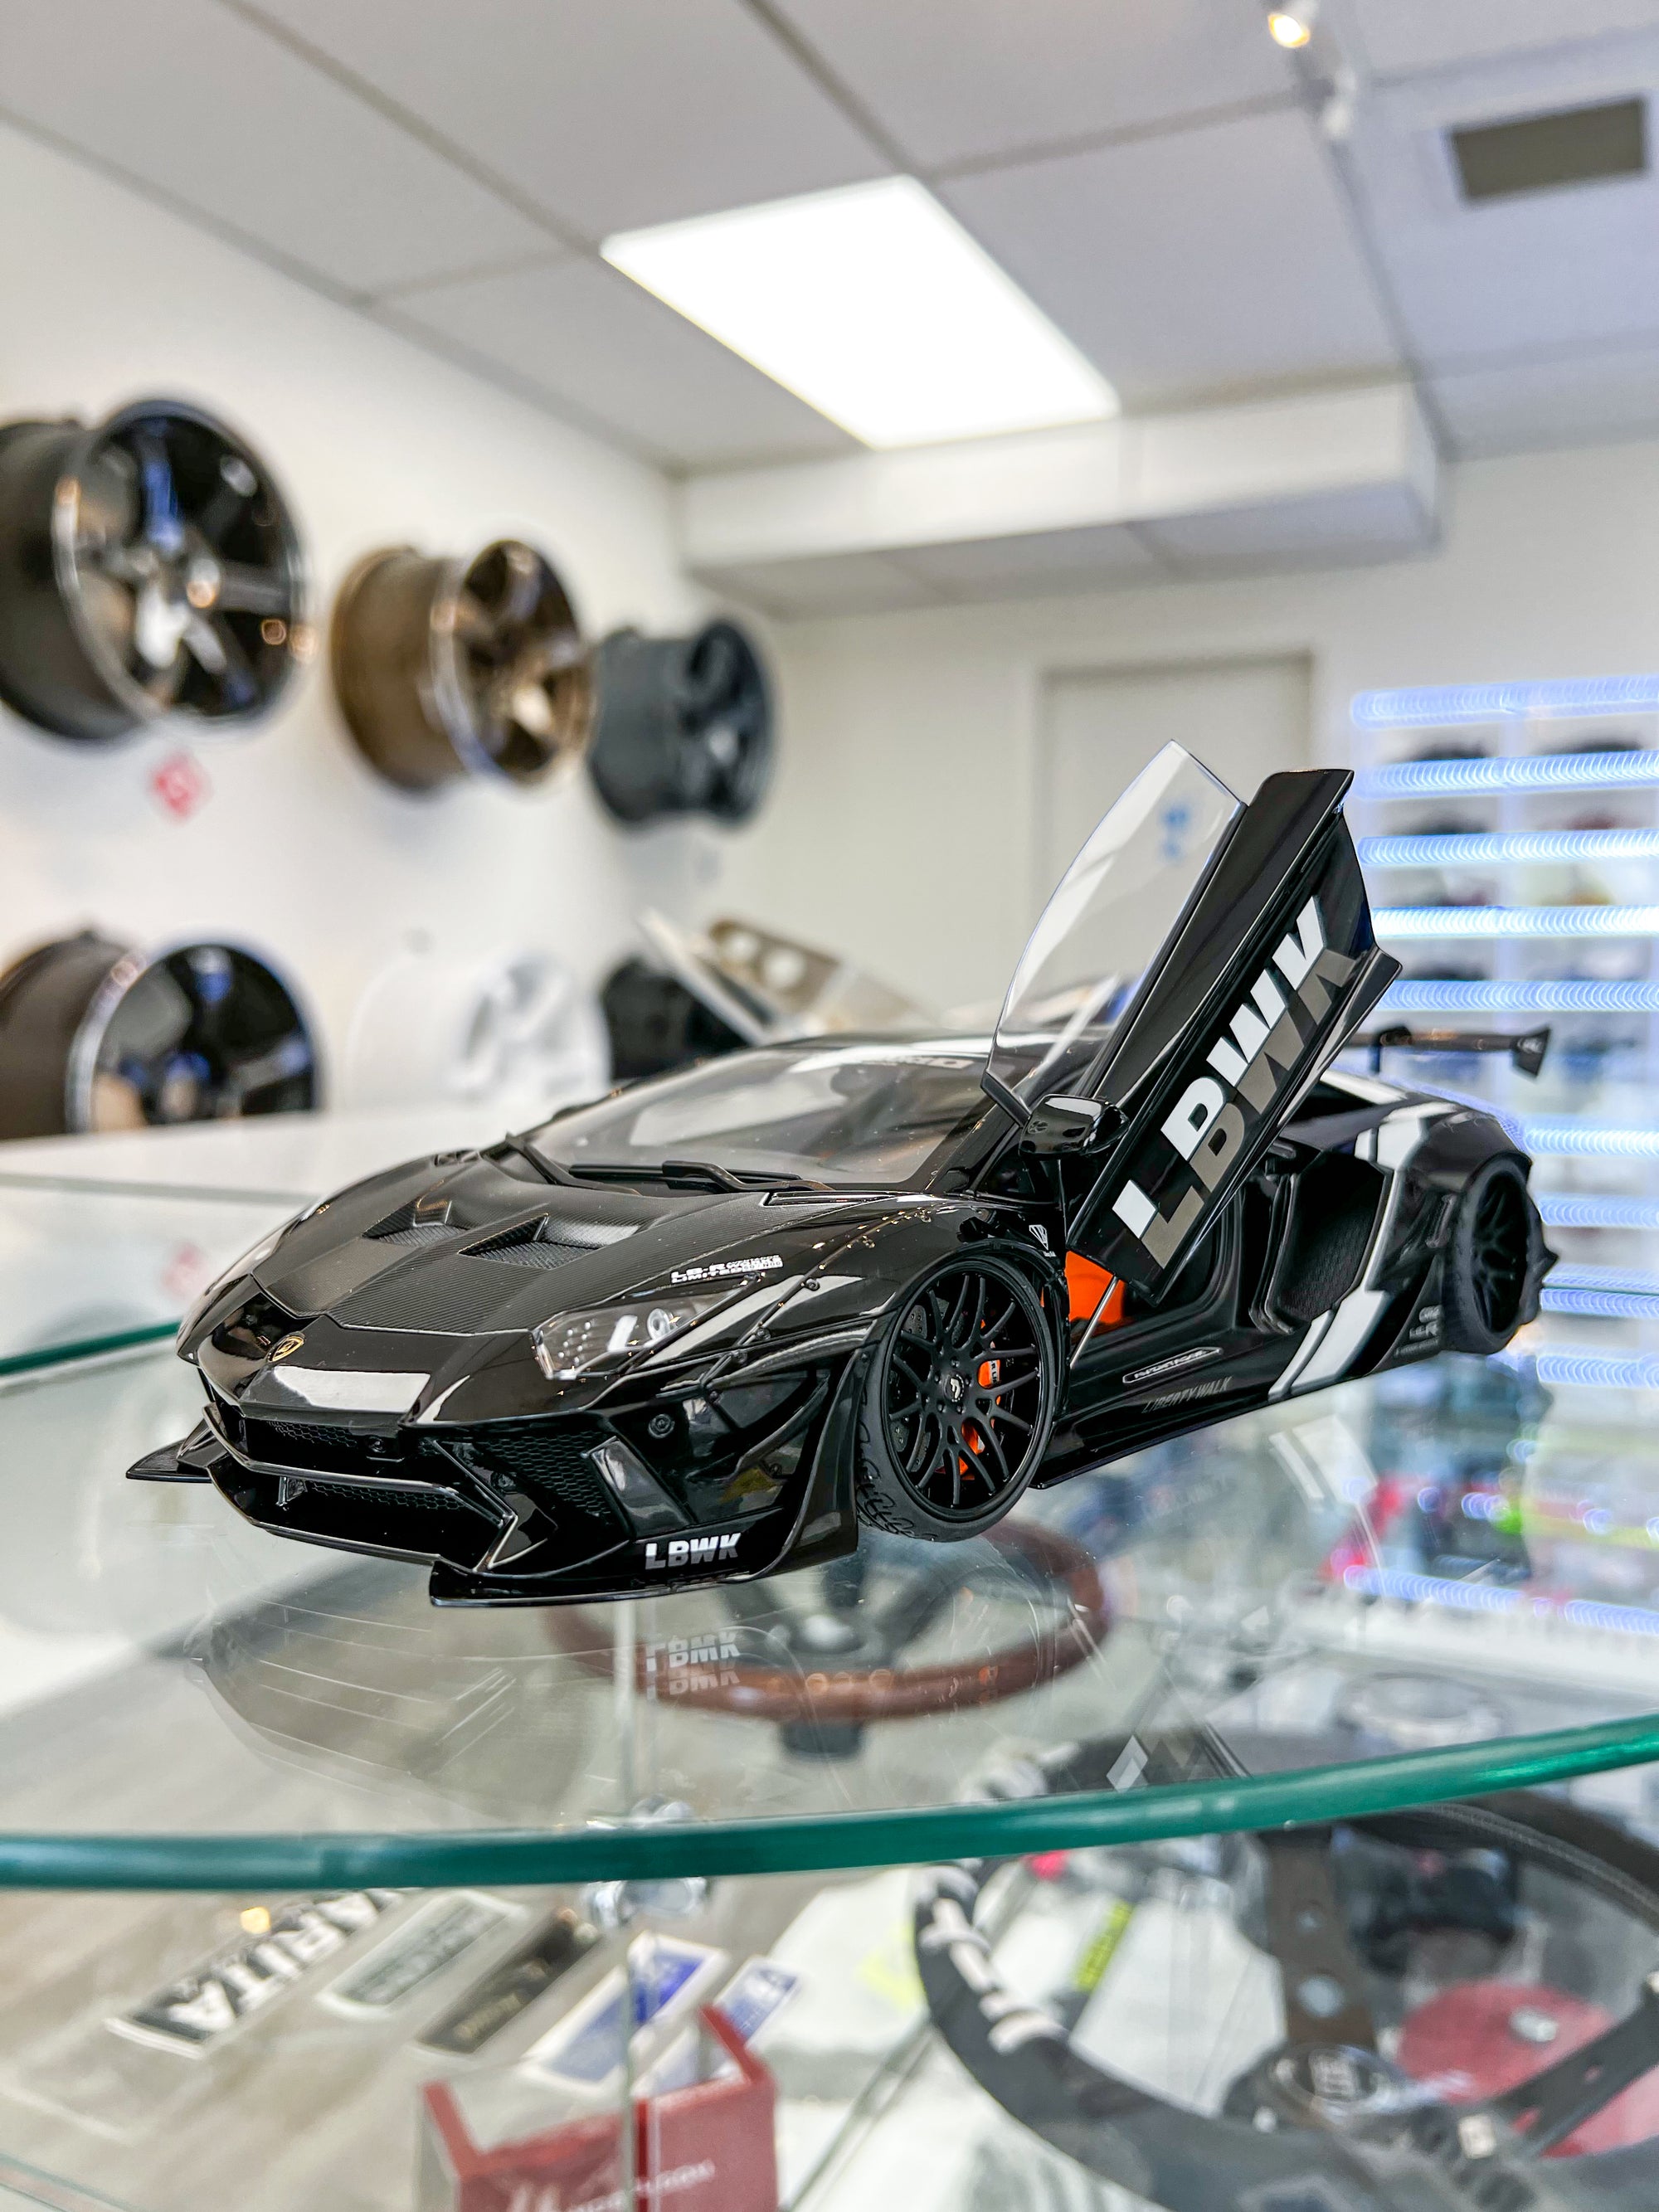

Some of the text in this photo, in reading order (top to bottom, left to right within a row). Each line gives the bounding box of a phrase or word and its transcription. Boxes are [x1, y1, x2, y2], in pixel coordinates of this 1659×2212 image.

[1112, 895, 1357, 1269] LBWK
[1194, 1376, 1233, 1399] WALK
[645, 1533, 741, 1569] LBWK
